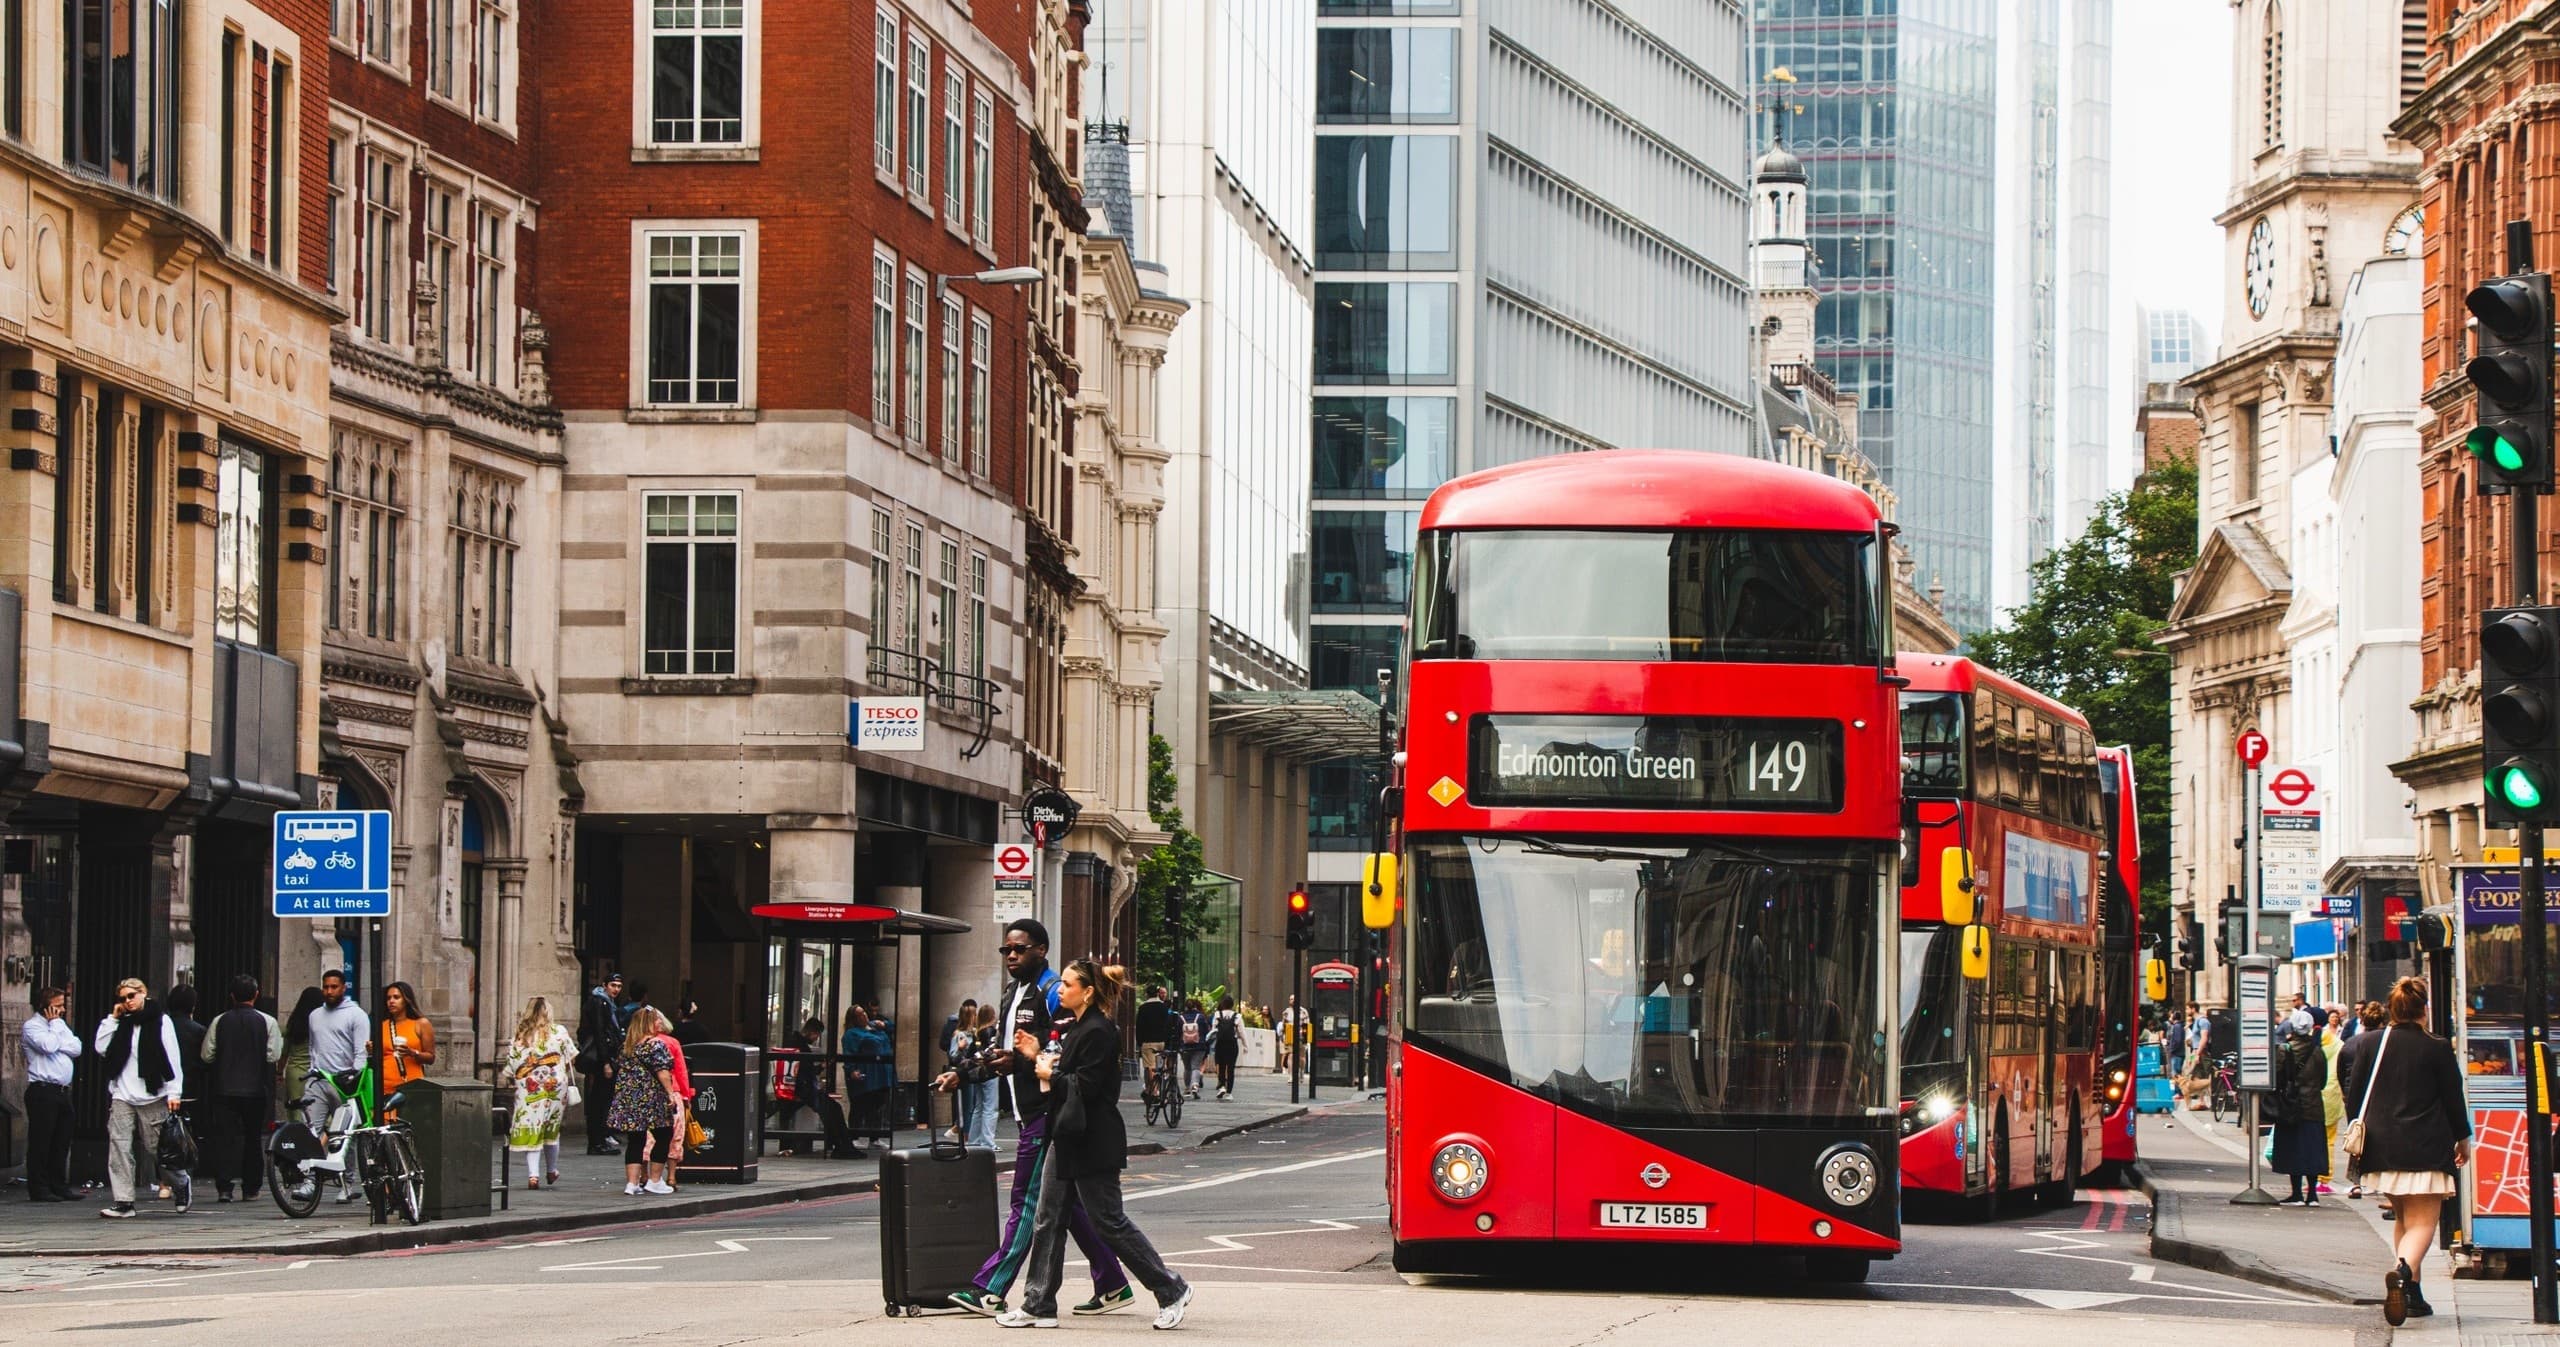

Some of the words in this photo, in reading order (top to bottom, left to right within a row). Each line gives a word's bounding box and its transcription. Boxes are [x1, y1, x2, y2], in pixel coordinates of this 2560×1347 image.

[864, 707, 919, 719] TESCO
[864, 726, 919, 740] express
[2246, 736, 2262, 759] F
[1497, 743, 1617, 779] Edmonton
[1626, 746, 1696, 780] Green
[1748, 740, 1808, 793] 149
[1033, 806, 1055, 816] Dirty
[1033, 813, 1064, 822] martini
[1038, 825, 1045, 841] K
[284, 874, 309, 885] taxi
[293, 897, 309, 909] At
[313, 897, 330, 909] all
[335, 897, 371, 909] times
[1610, 1206, 1646, 1223] LTZ
[1655, 1207, 1697, 1225] 1585
